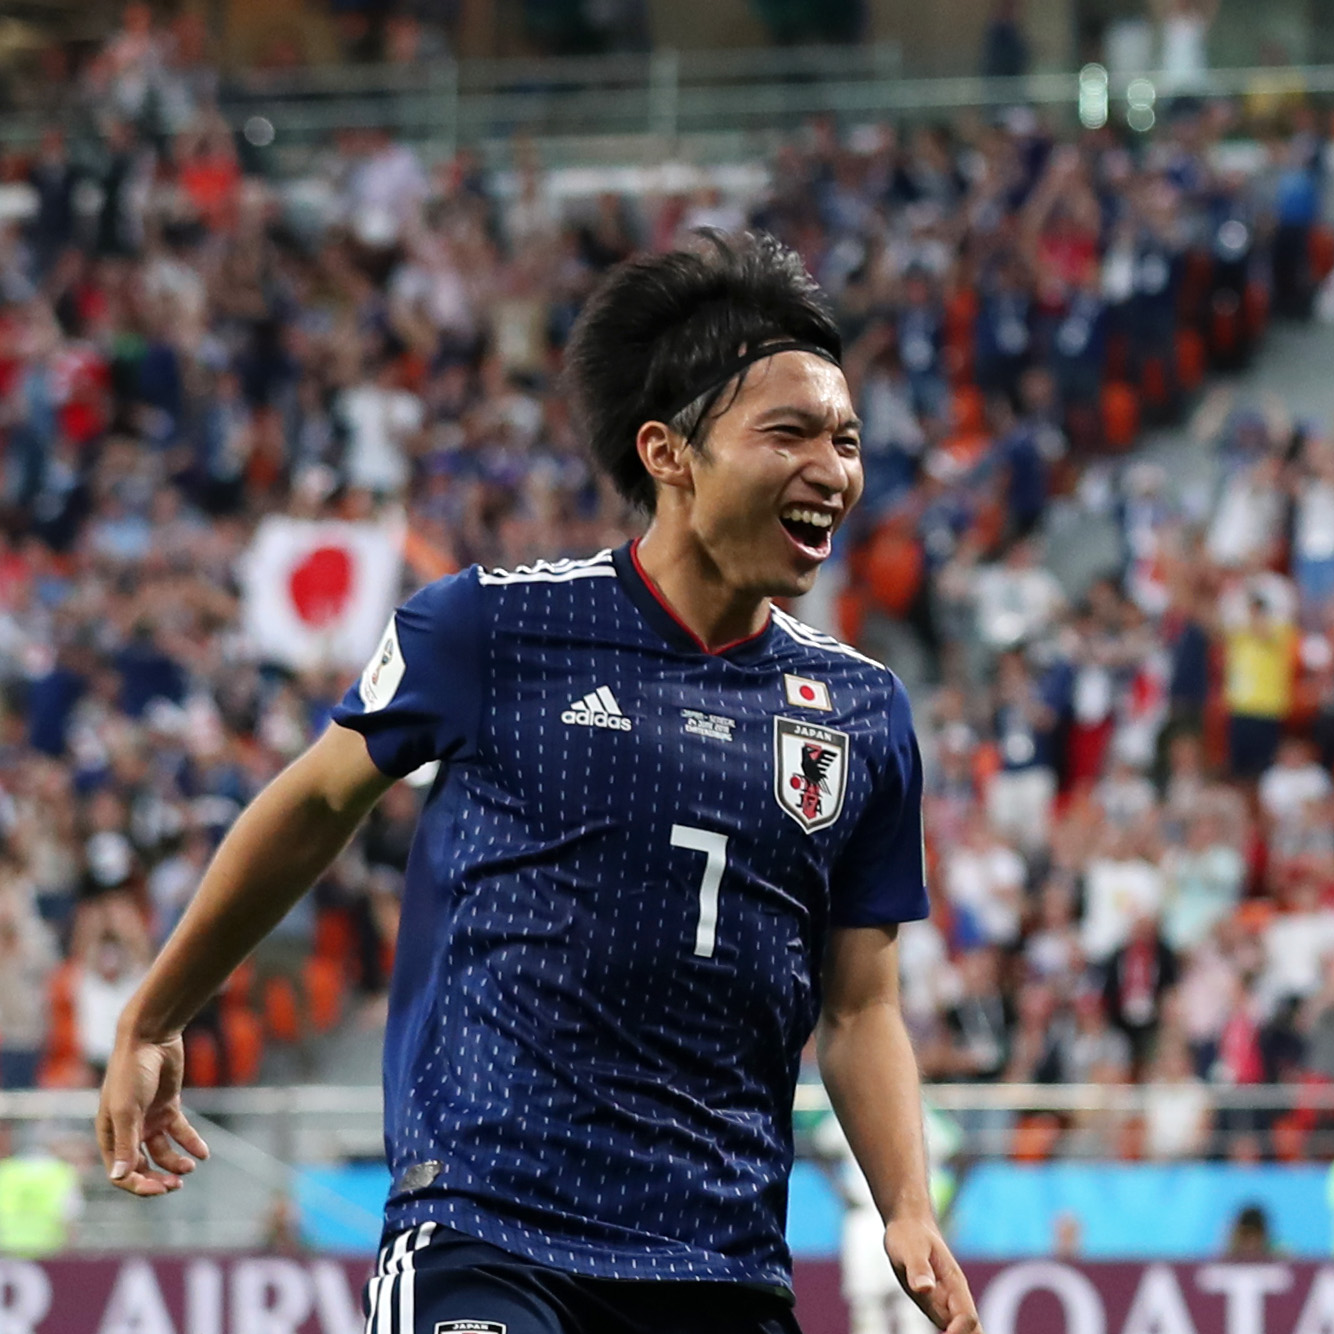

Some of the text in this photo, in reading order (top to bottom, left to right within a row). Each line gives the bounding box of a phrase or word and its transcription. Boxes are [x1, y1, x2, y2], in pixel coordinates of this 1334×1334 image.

[561, 708, 632, 731] adidas
[794, 725, 832, 742] JAPAN
[670, 823, 728, 958] 7
[452, 1323, 489, 1331] JAPAN
